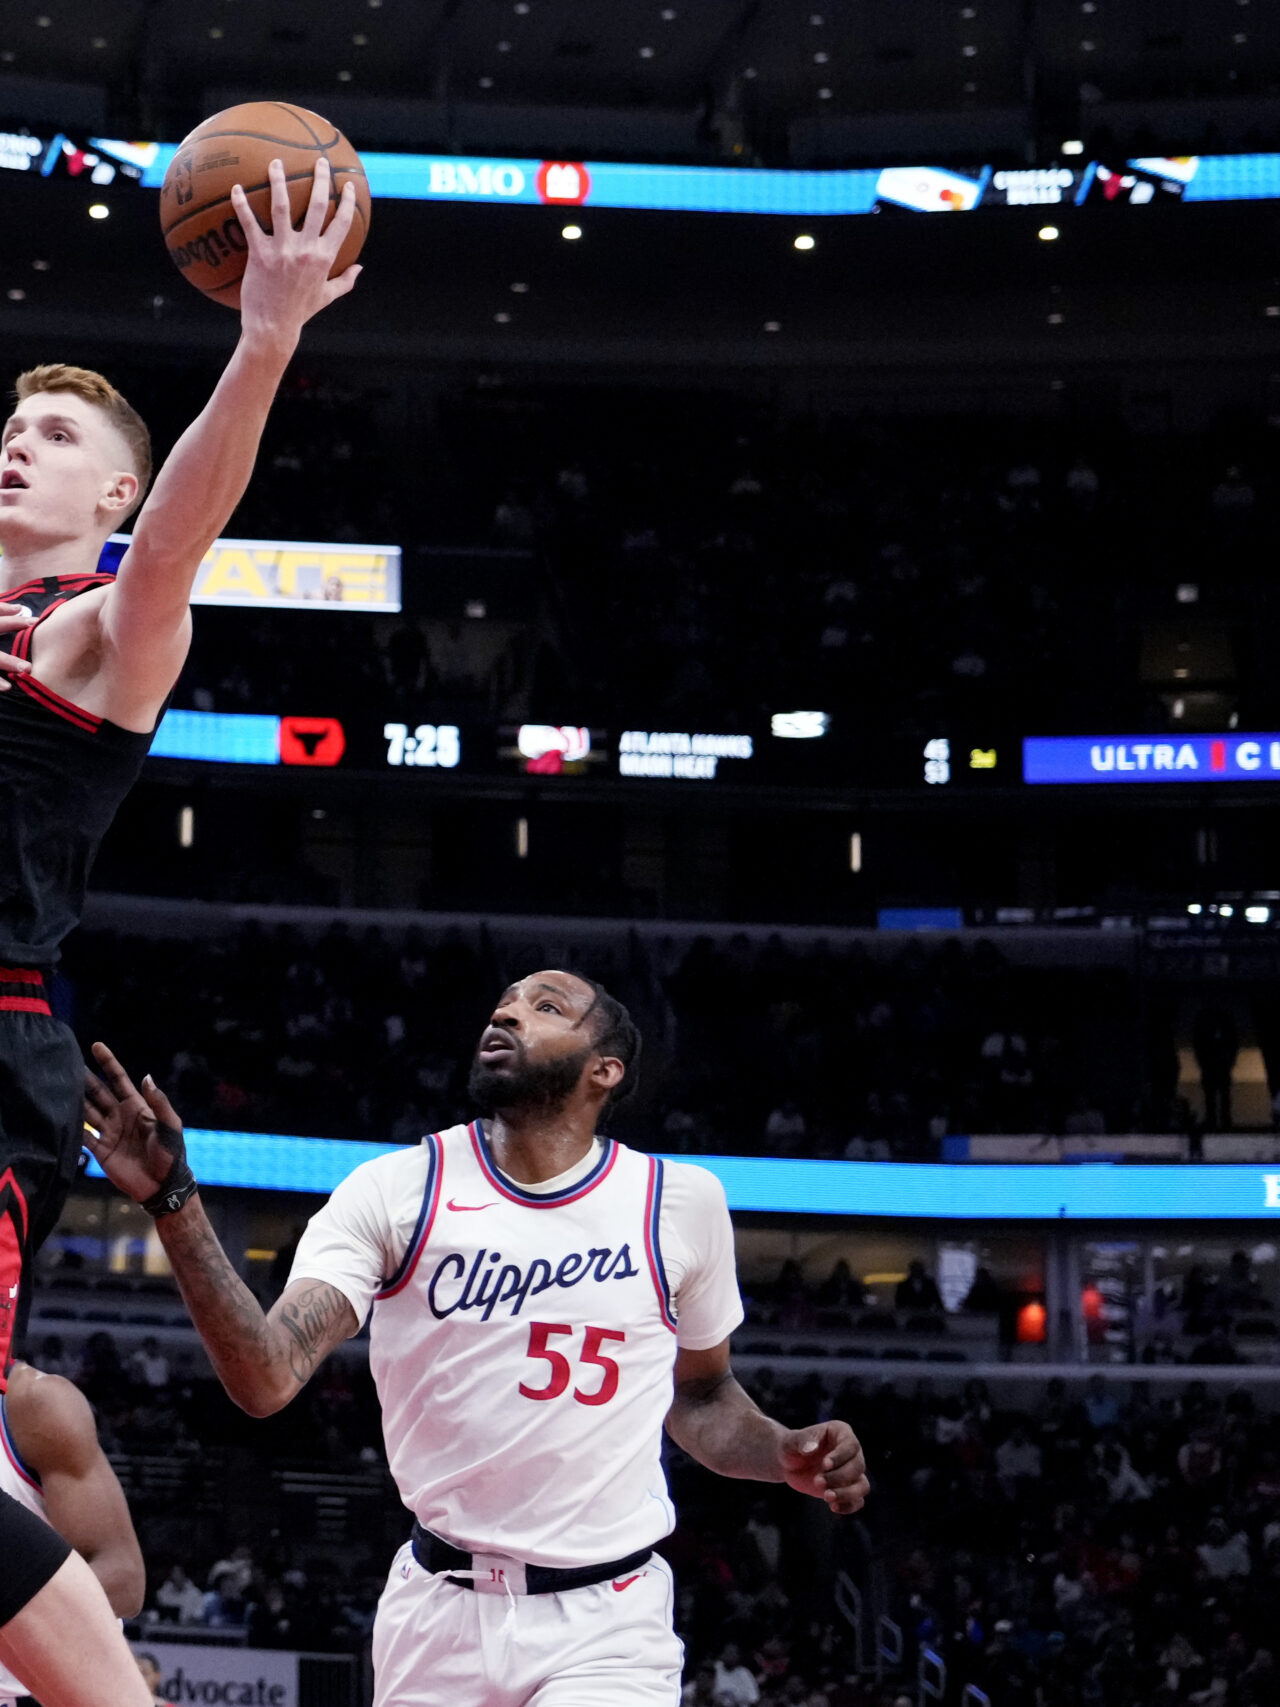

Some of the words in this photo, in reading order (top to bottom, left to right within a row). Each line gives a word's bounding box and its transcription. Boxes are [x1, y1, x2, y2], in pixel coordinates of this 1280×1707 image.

[428, 162, 525, 197] BMO
[383, 722, 461, 768] 7:25
[1090, 744, 1199, 771] ULTRA
[428, 1243, 640, 1322] Clippers
[518, 1321, 626, 1406] 55
